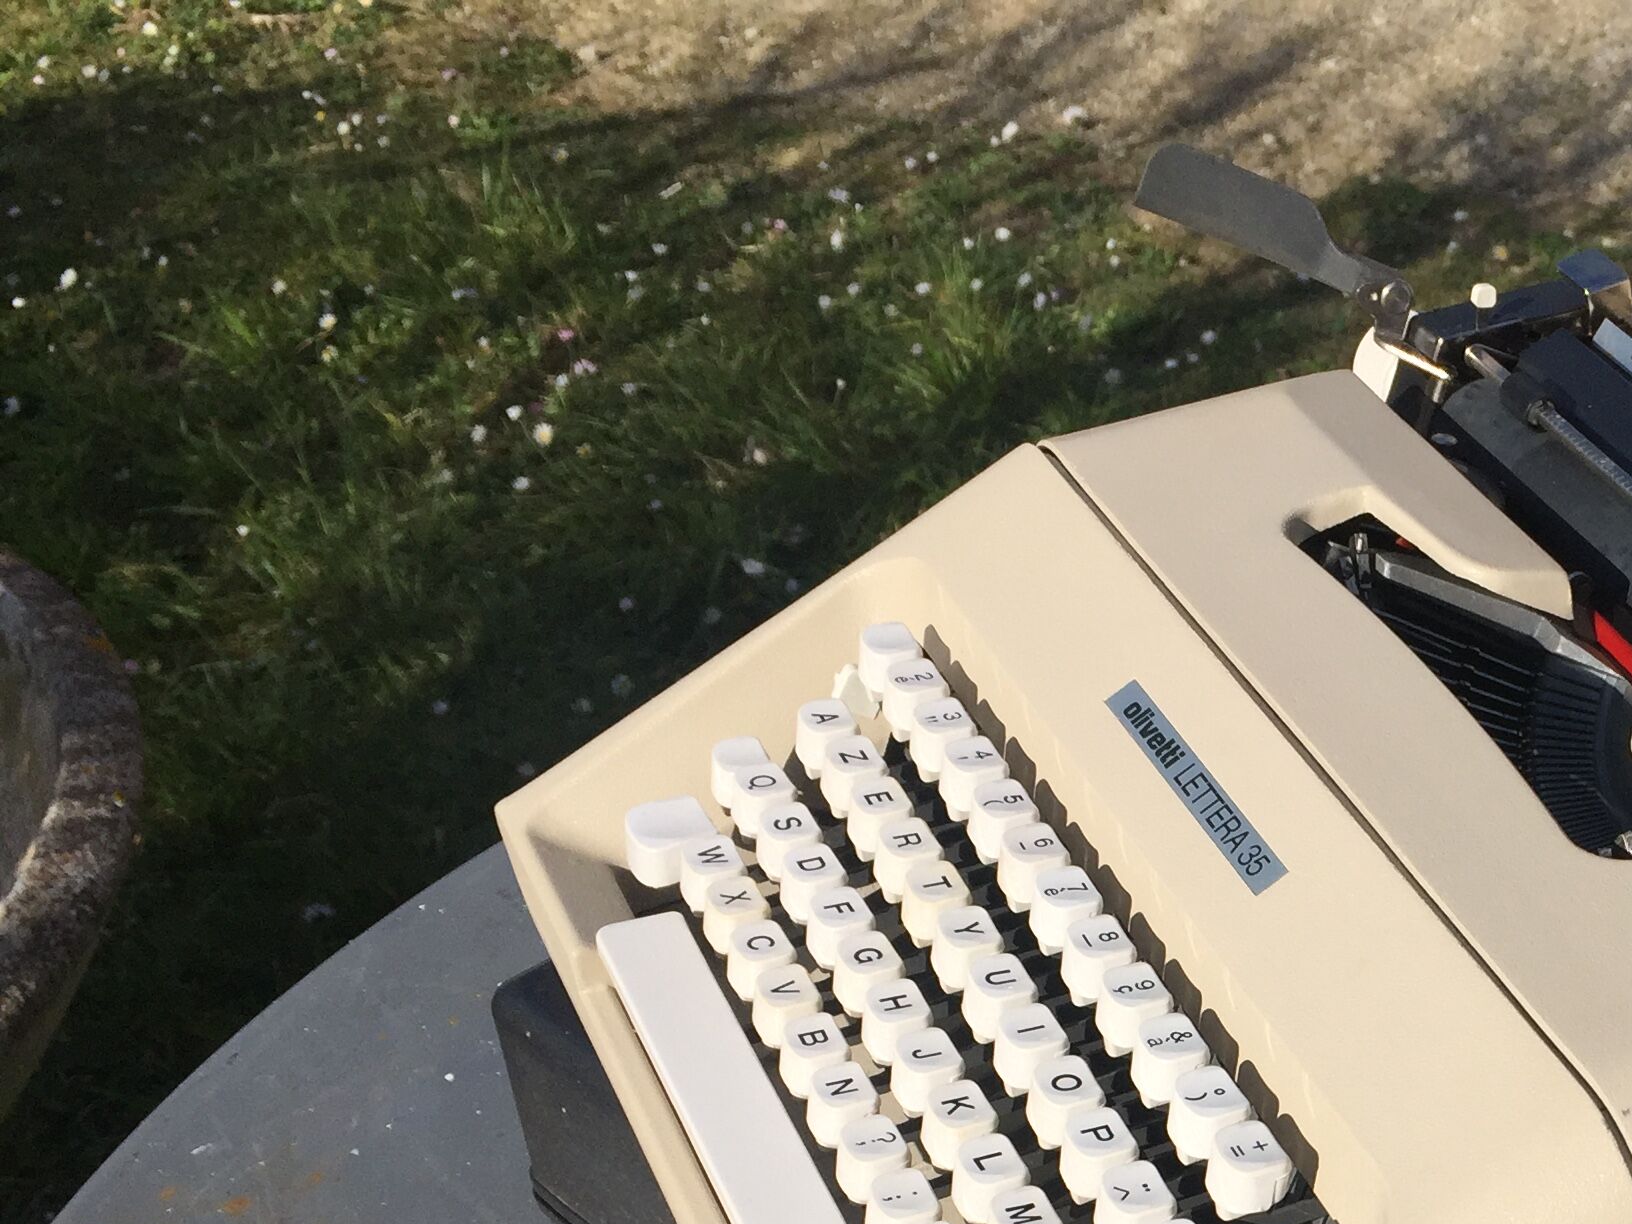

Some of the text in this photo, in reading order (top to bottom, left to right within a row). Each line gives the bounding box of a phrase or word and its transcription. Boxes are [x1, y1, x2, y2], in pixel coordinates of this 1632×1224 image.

[811, 713, 840, 725] A
[838, 749, 869, 764] Z
[747, 774, 777, 790] Q
[1122, 701, 1271, 876] olivetti LETTERA 35
[863, 791, 894, 806] E
[1003, 793, 1025, 804] 5
[773, 816, 803, 831] S
[892, 832, 922, 848] R
[1033, 836, 1056, 848] 6
[697, 845, 729, 864] W
[796, 856, 826, 872] D
[922, 875, 953, 889] T
[719, 890, 752, 905] X
[823, 901, 856, 914] F
[953, 920, 986, 935] Y
[746, 935, 776, 951] C
[1098, 929, 1120, 943] 8
[853, 947, 884, 965] G
[984, 969, 1017, 986] U
[770, 980, 801, 994] V
[878, 994, 913, 1012] H
[797, 1029, 829, 1047] B
[911, 1049, 942, 1059] J
[825, 1077, 859, 1097] N
[1051, 1073, 1083, 1092] O
[941, 1095, 976, 1116] K
[1080, 1124, 1115, 1142] P
[972, 1151, 1003, 1172] L
